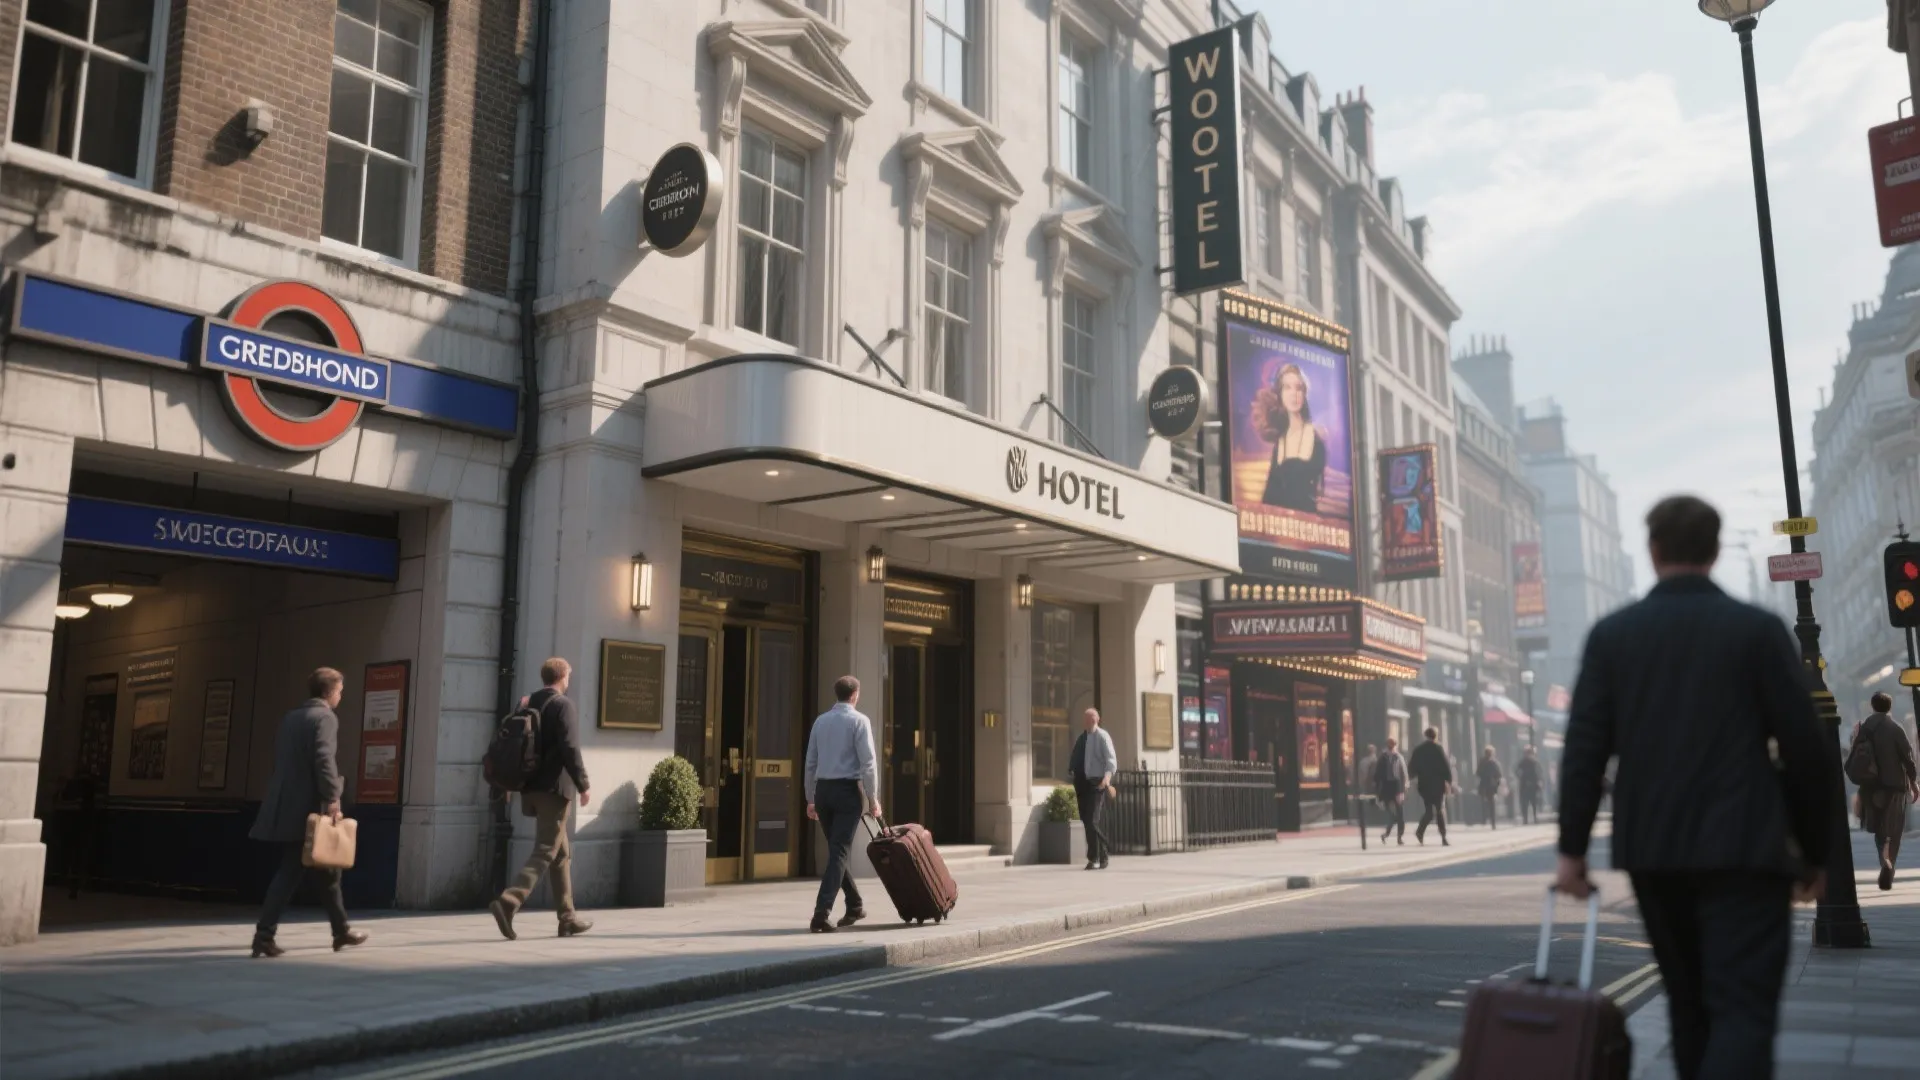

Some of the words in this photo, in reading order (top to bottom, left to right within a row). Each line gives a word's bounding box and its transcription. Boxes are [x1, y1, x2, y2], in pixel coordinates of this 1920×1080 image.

[1184, 46, 1221, 271] WOOTEL
[218, 333, 380, 392] GREDBHOND
[1038, 460, 1126, 521] HOTEL
